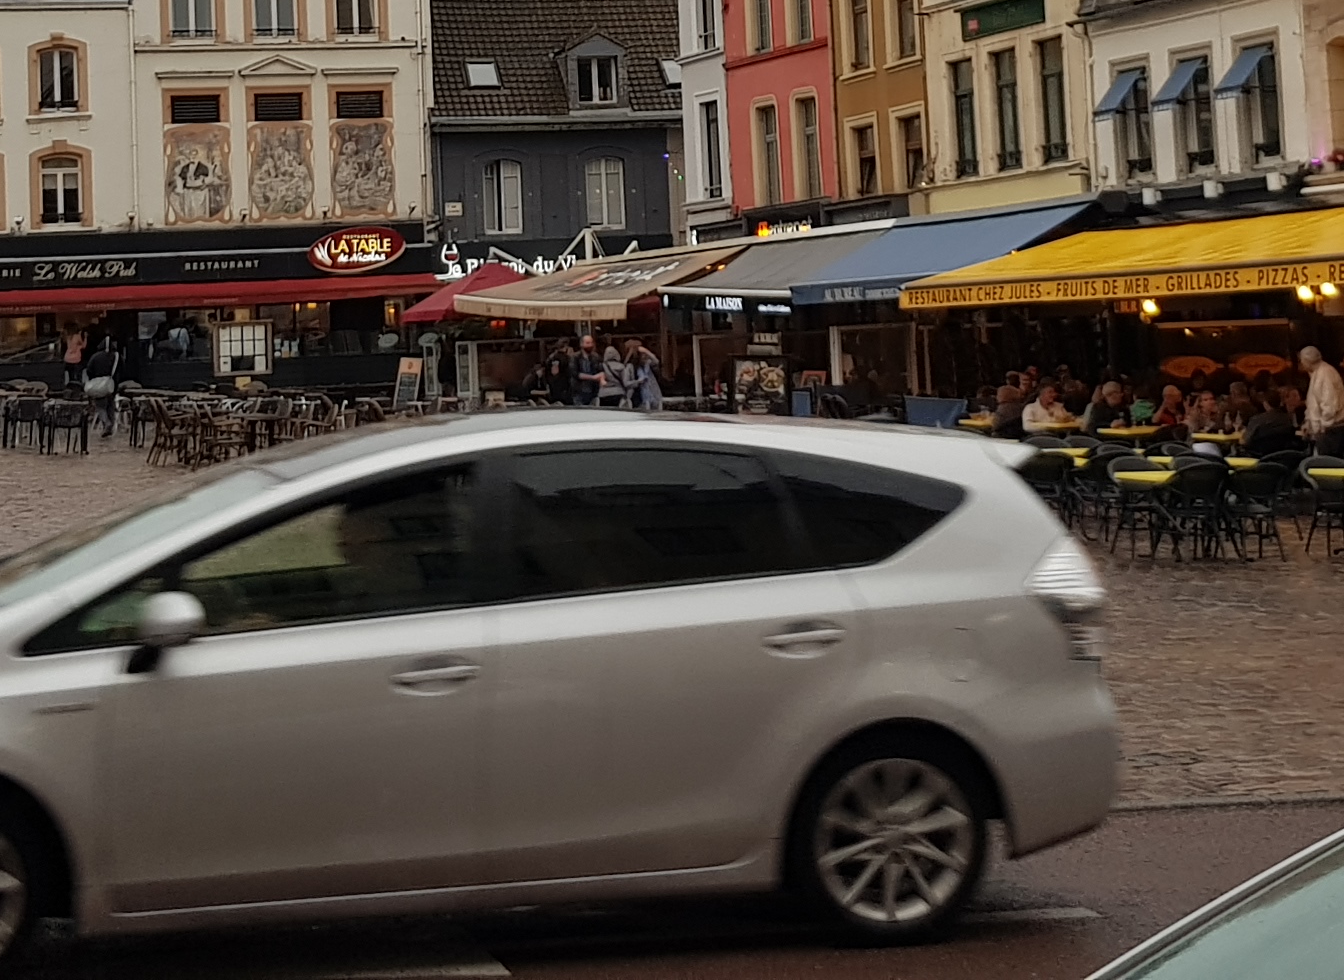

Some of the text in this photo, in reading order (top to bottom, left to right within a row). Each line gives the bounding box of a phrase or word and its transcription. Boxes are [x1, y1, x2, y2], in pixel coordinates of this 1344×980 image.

[330, 238, 392, 254] LA TABLE
[33, 260, 136, 280] Le Welsh Pub
[184, 259, 260, 271] RESTAURANT
[533, 256, 555, 273] du
[907, 287, 973, 305] RESTAURANT
[976, 284, 1004, 302] CHEZ
[1008, 282, 1042, 299] JULES
[1055, 280, 1097, 297] FRUITS
[1102, 279, 1118, 295] DE
[1123, 277, 1150, 294] MER
[1166, 270, 1240, 292] GRILLADES
[1257, 266, 1309, 286] PIZZAS
[714, 297, 743, 311] MAISON
